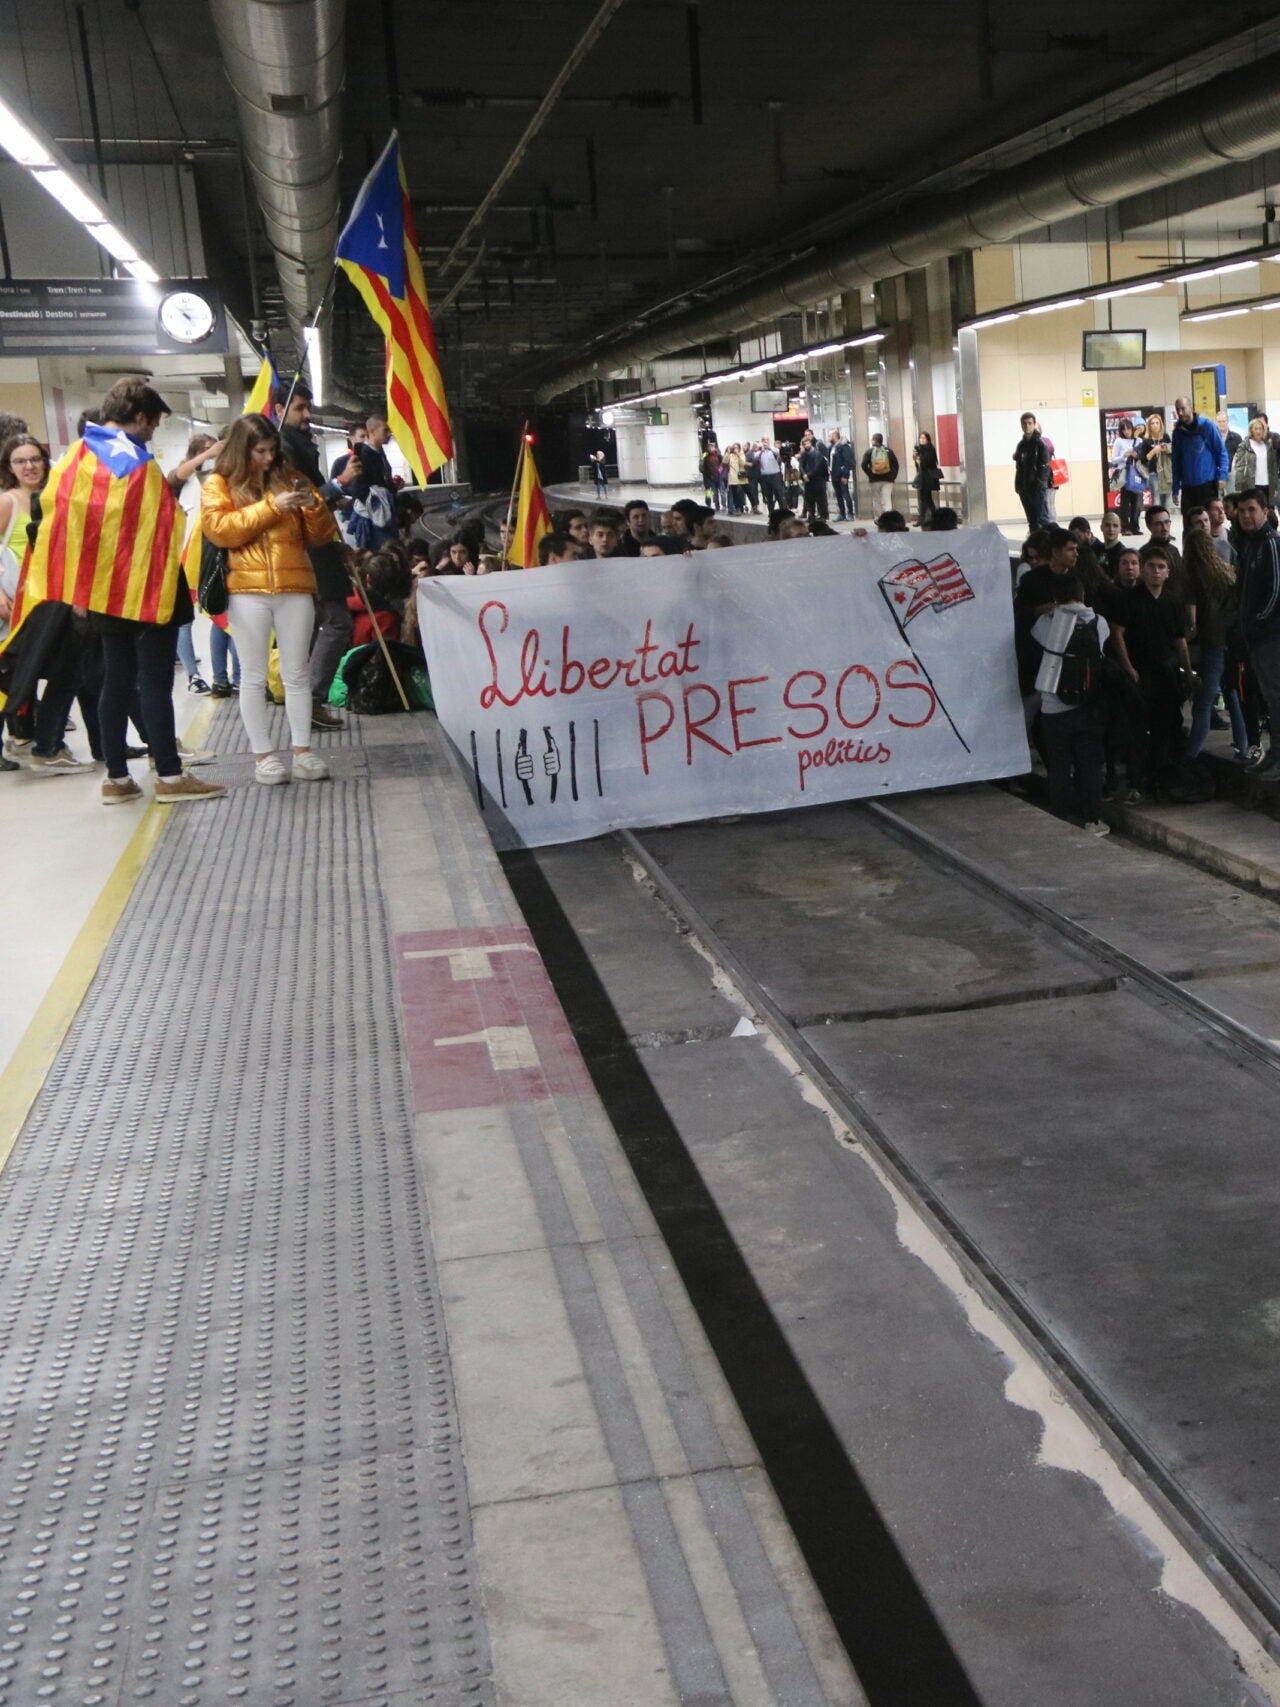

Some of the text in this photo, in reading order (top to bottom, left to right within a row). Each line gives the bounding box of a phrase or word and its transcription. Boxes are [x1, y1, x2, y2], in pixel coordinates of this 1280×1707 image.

[45, 310, 74, 318] Destino
[478, 600, 701, 709] Llibertat
[635, 659, 936, 775] PRESOS
